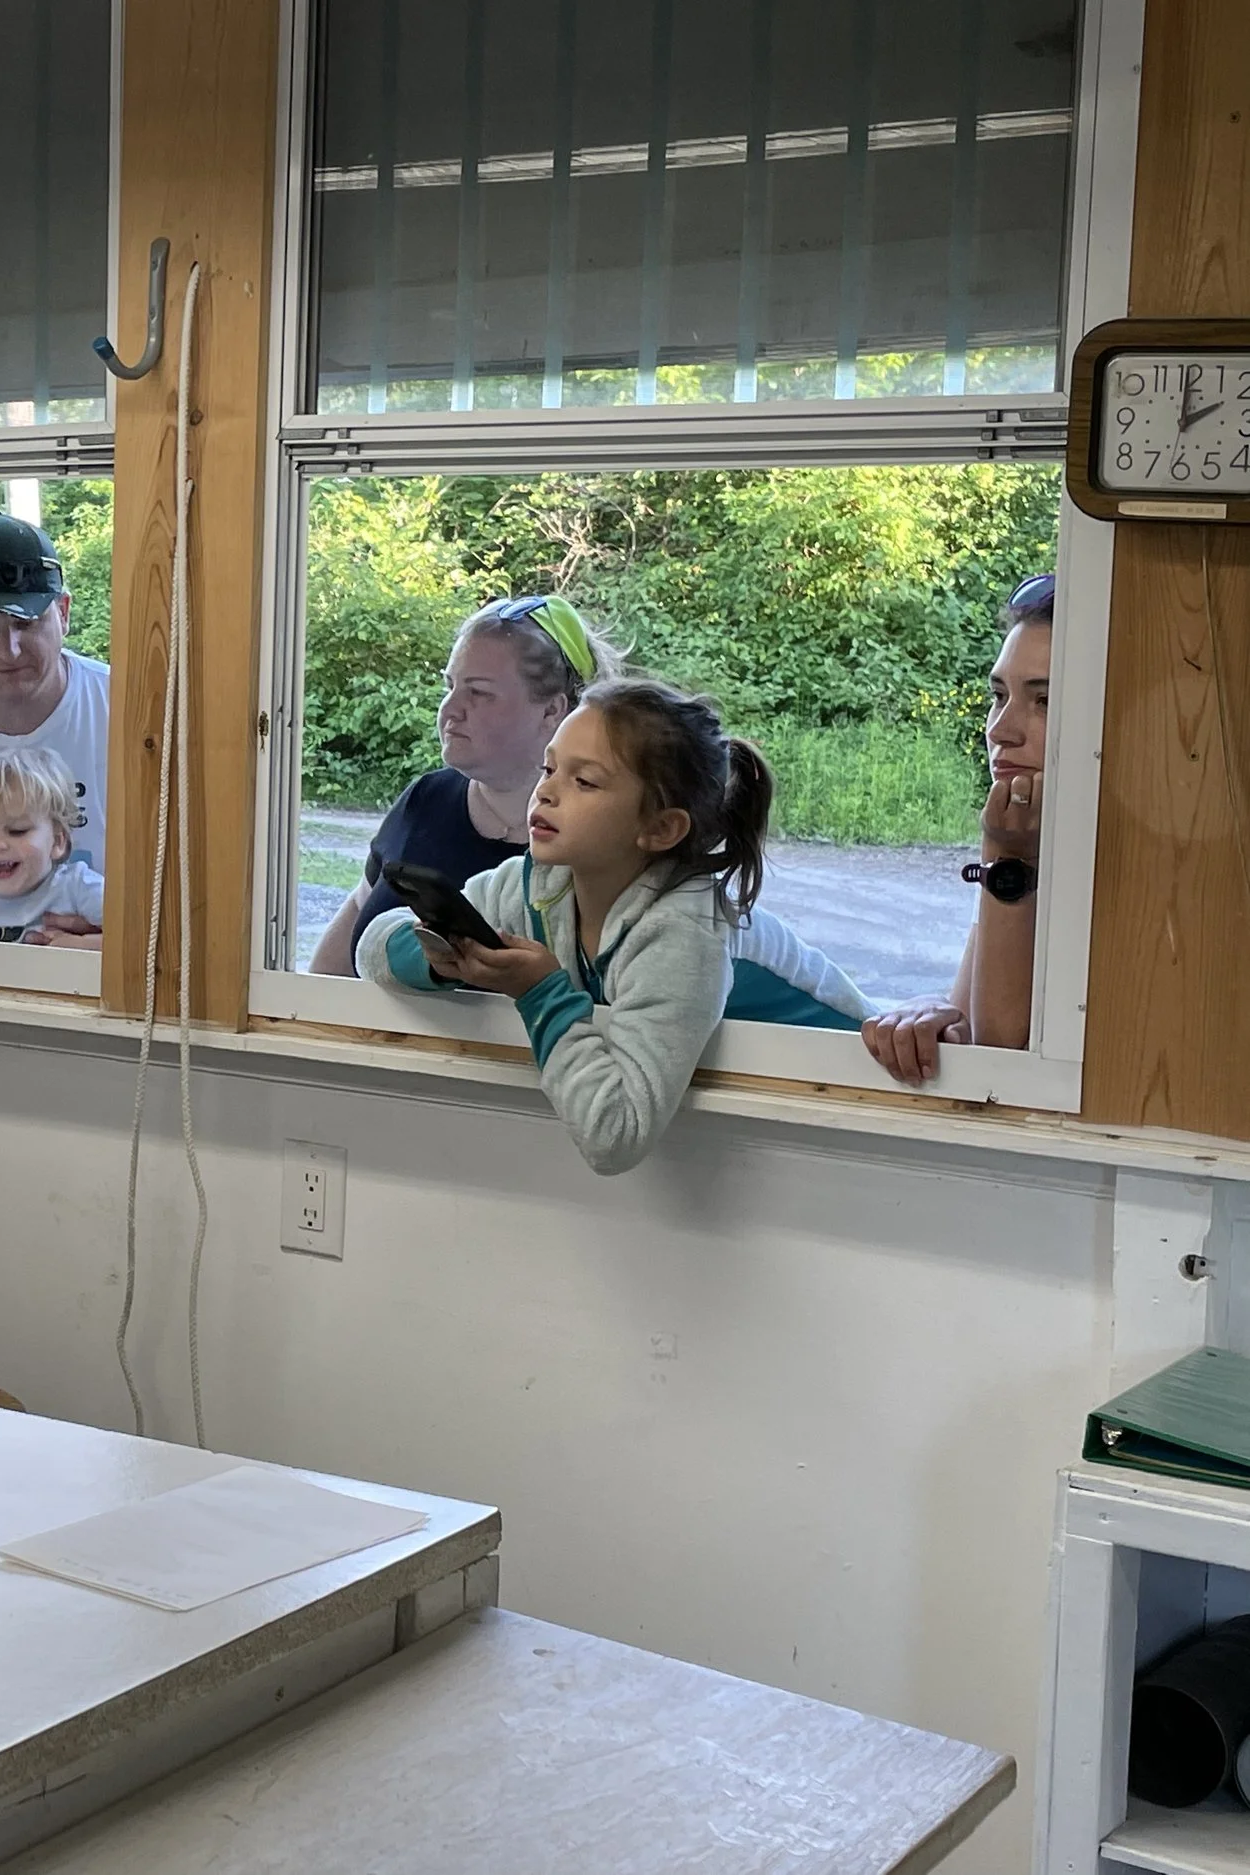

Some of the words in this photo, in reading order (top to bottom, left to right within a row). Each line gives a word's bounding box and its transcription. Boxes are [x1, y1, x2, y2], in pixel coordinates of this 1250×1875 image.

[1115, 371, 1145, 396] 10
[1153, 365, 1168, 392] 11
[1178, 363, 1203, 392] 12
[1216, 365, 1225, 393] 1
[1116, 407, 1136, 435] 9
[1116, 442, 1133, 471] 8
[1144, 451, 1161, 479] 7
[1171, 453, 1191, 481] 6
[1201, 452, 1221, 481] 5
[1229, 444, 1250, 472] 4
